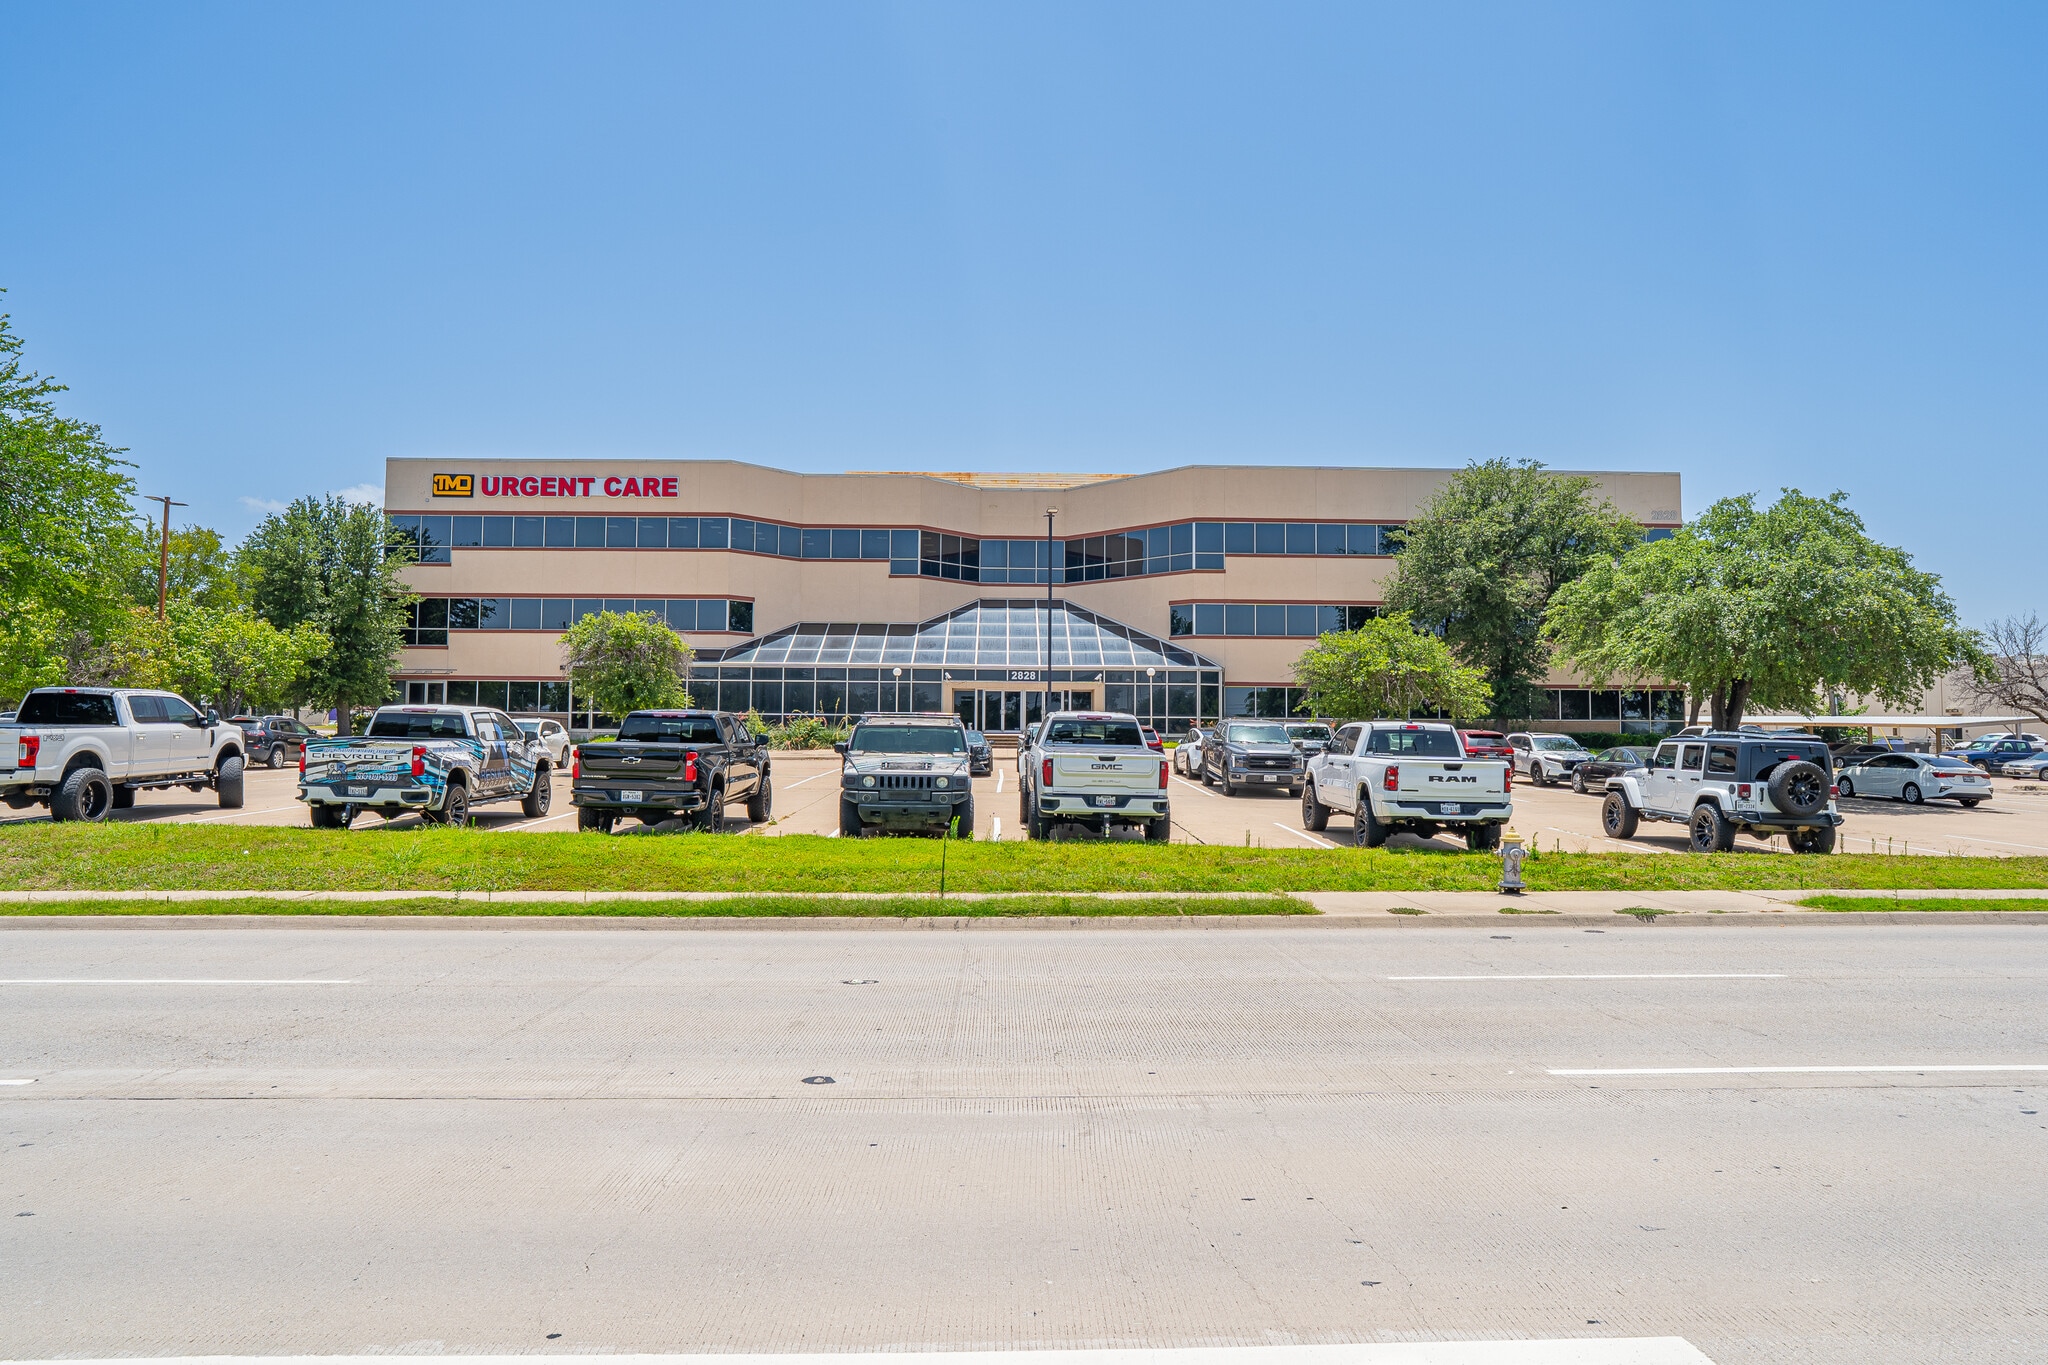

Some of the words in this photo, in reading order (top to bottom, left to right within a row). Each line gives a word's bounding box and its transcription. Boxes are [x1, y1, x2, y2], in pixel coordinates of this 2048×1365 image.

[481, 476, 596, 498] URGENT
[603, 477, 680, 498] CARE
[1011, 671, 1036, 680] 2828
[312, 752, 404, 761] CHEVROLET
[480, 767, 511, 781] RESULTS
[1428, 775, 1478, 783] RAM
[480, 778, 510, 789] ROOFING
